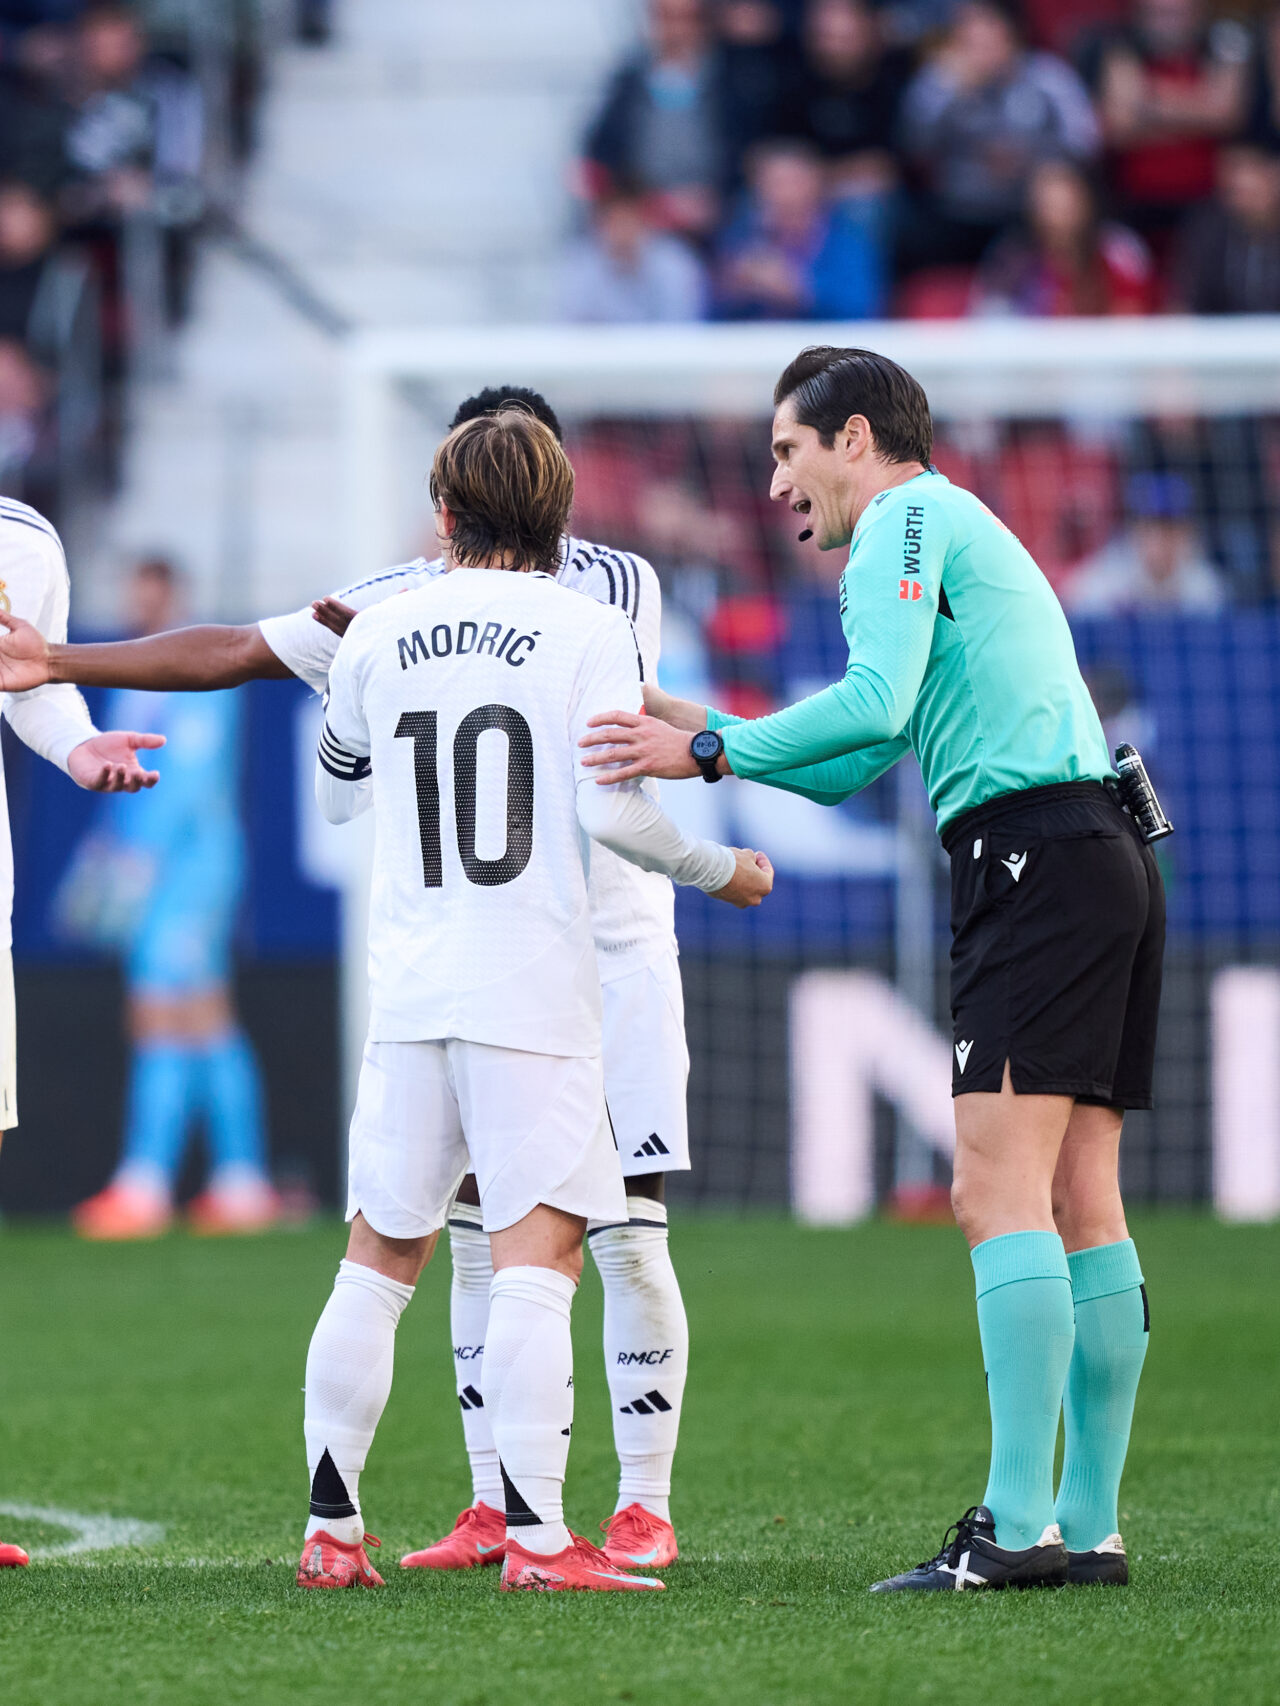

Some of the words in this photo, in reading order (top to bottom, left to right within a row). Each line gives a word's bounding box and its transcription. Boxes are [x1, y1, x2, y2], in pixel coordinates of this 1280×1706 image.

[903, 505, 925, 575] WÜRTH
[397, 621, 542, 671] MODRIĆ
[393, 703, 535, 888] 10
[617, 1348, 674, 1366] RMCF
